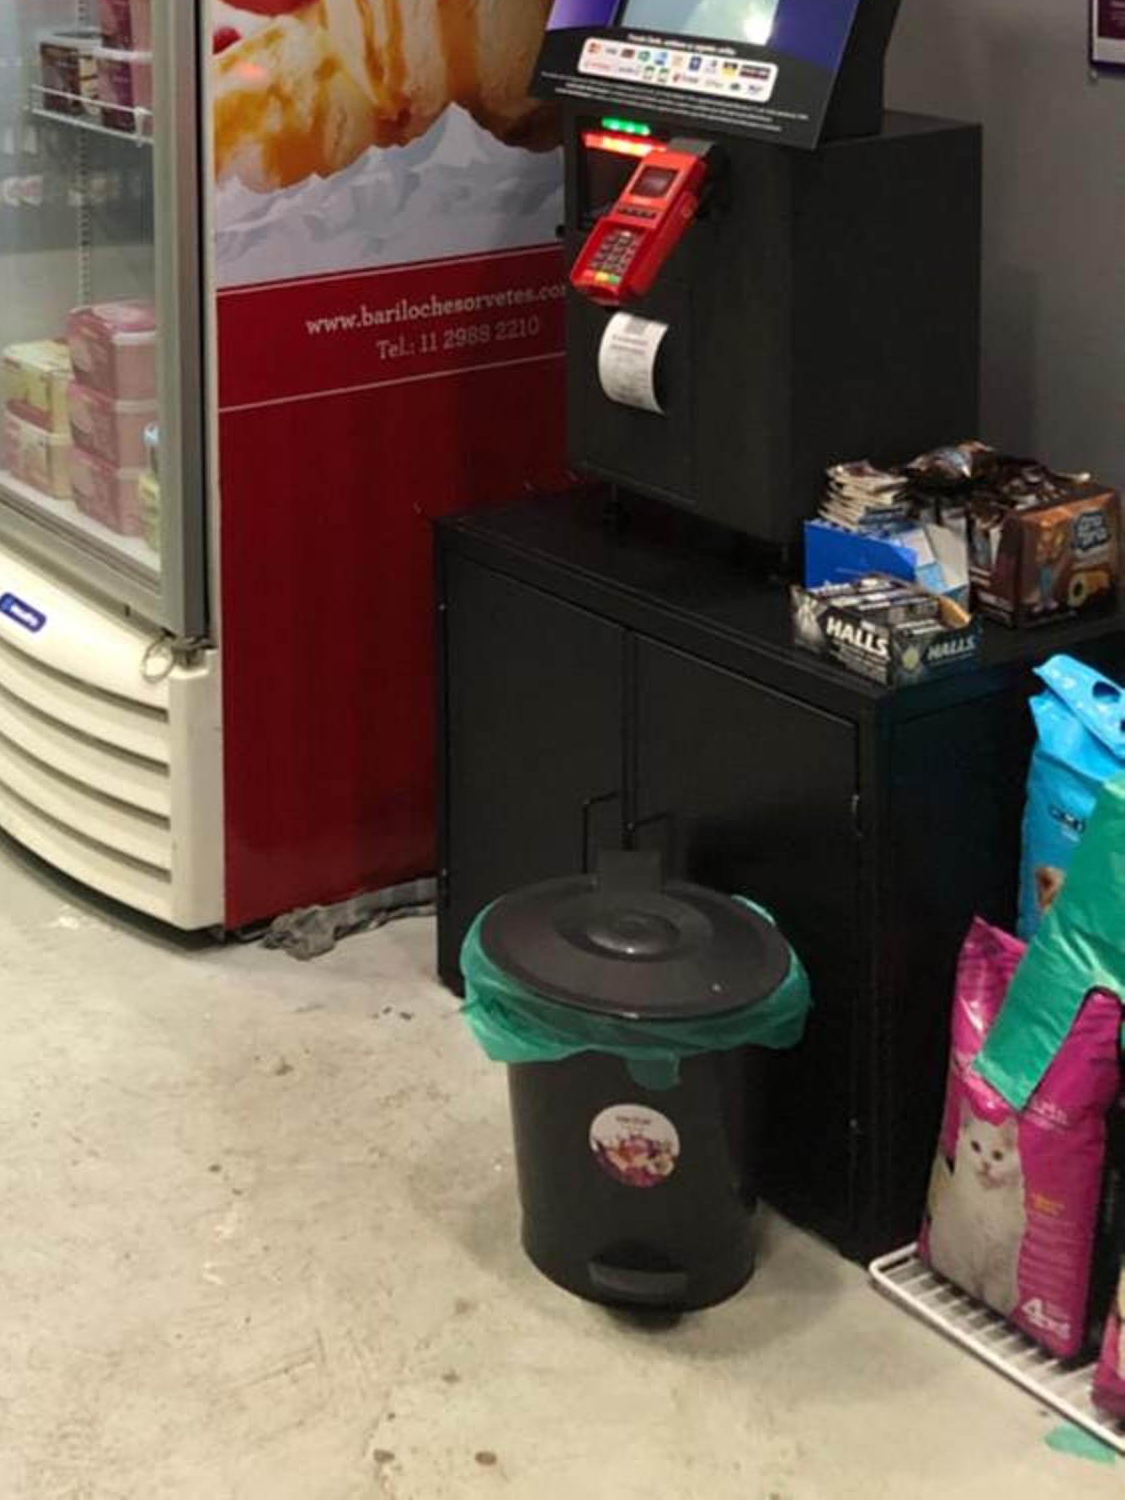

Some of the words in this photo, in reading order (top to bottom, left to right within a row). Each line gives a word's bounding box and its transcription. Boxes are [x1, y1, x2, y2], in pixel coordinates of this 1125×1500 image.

[420, 333, 438, 354] 11
[826, 616, 889, 656] HALLS
[927, 635, 975, 660] HALLS
